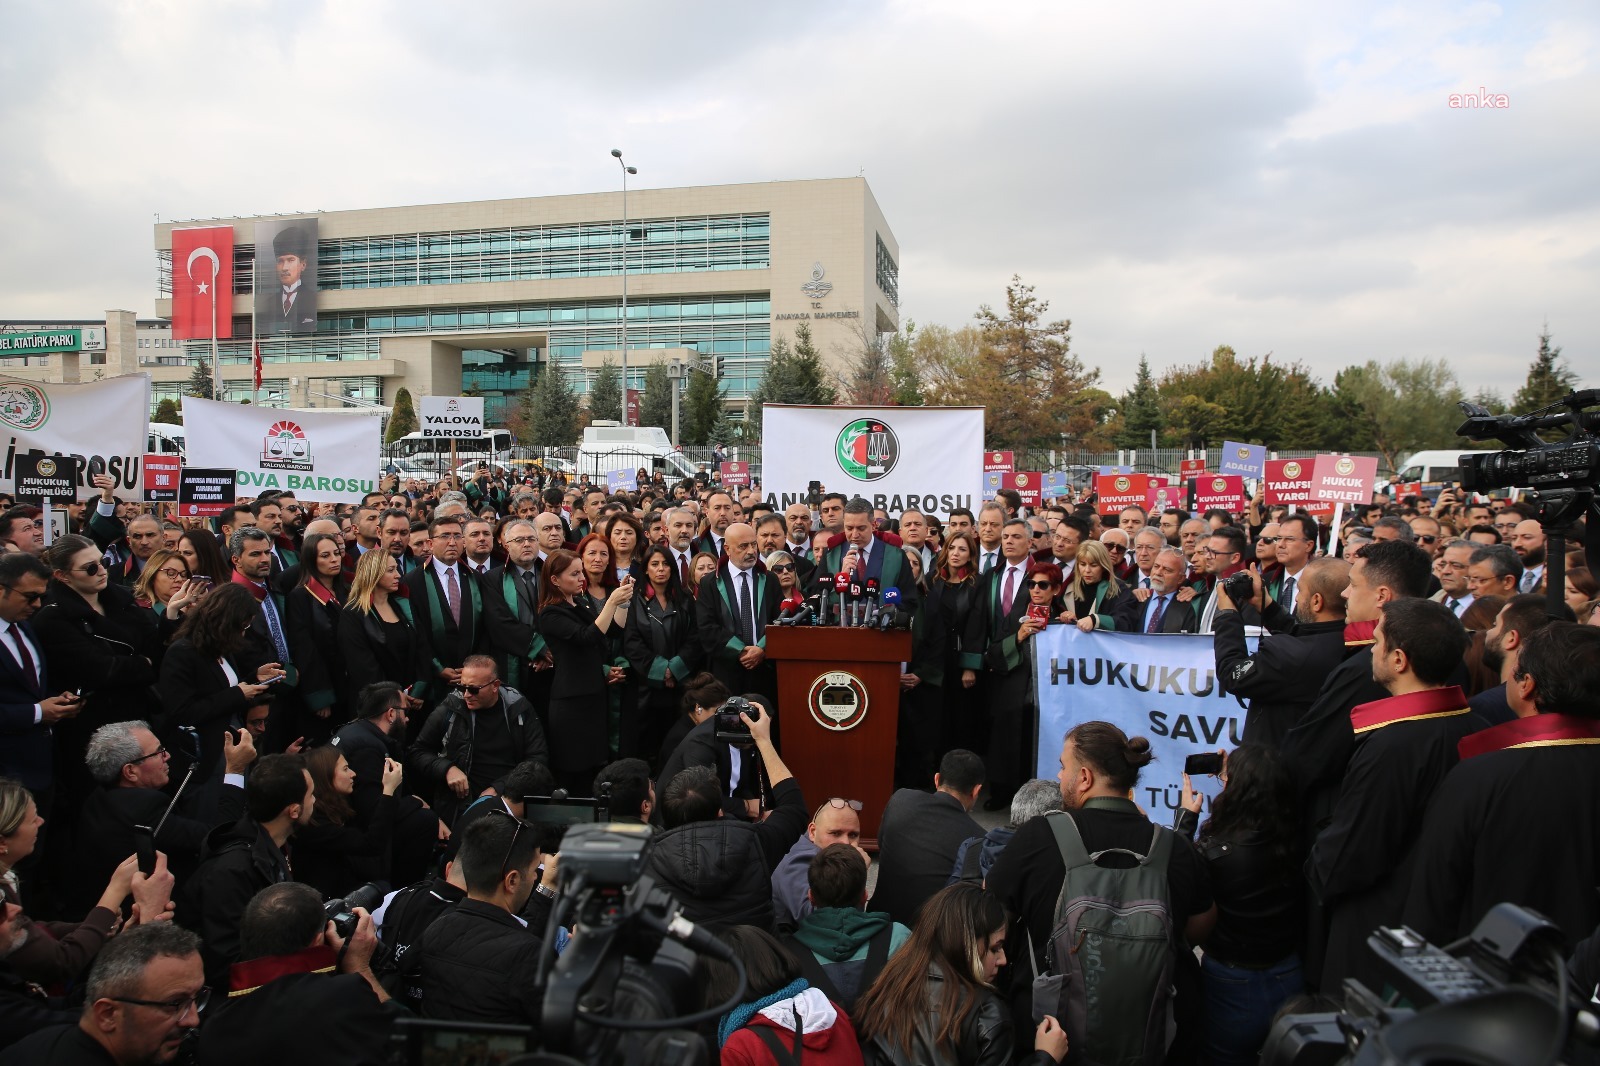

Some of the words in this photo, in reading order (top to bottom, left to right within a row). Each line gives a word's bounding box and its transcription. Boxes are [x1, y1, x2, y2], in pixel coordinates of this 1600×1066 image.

[775, 312, 811, 320] ANAYASA
[814, 310, 859, 319] MAHKEMESİ
[14, 334, 48, 348] ATATÜRK
[49, 334, 74, 346] PARKI
[425, 415, 481, 424] YALOVA
[423, 429, 482, 437] BAROSU
[1224, 462, 1259, 473] ADALET
[23, 477, 70, 486] HUKUKUN
[155, 474, 170, 486] SON!
[236, 470, 280, 488] OVA
[287, 474, 374, 493] BAROSU
[1322, 476, 1363, 488] HUKUK
[1268, 481, 1312, 490] TARAFSI
[19, 486, 74, 496] ÜSTÜNLÜĞÜ
[1318, 489, 1364, 501] DEVLETİ
[1100, 495, 1146, 503] KUVVETLER
[1199, 494, 1241, 503] KUVVETLER
[1276, 492, 1309, 501] YARGI
[874, 494, 972, 513] BAROSU
[1204, 502, 1236, 510] AYRILIĞI
[1297, 501, 1331, 512] AİKLİK
[1149, 710, 1244, 747] SAVU
